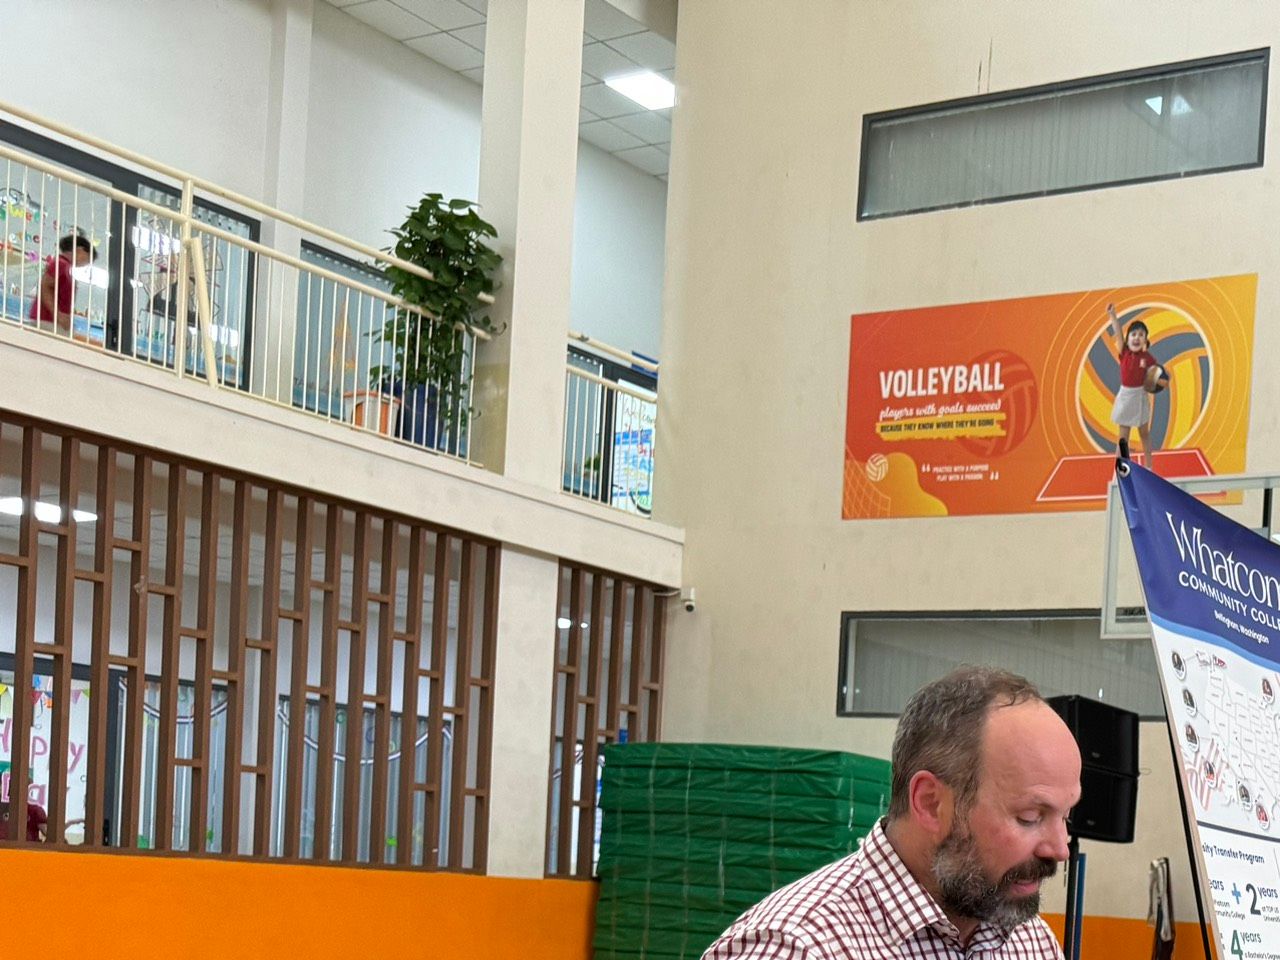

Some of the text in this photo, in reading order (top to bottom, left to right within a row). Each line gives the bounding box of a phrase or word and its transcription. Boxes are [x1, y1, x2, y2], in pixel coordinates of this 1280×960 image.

[879, 362, 1005, 399] VOLLEYBALL
[879, 398, 1002, 422] players with goals succeed
[1178, 570, 1248, 617] COMMUNITY
[1214, 845, 1239, 858] Transfer
[1239, 850, 1265, 865] Program
[1245, 882, 1262, 916] 2
[1257, 886, 1279, 900] years
[1240, 931, 1263, 944] years
